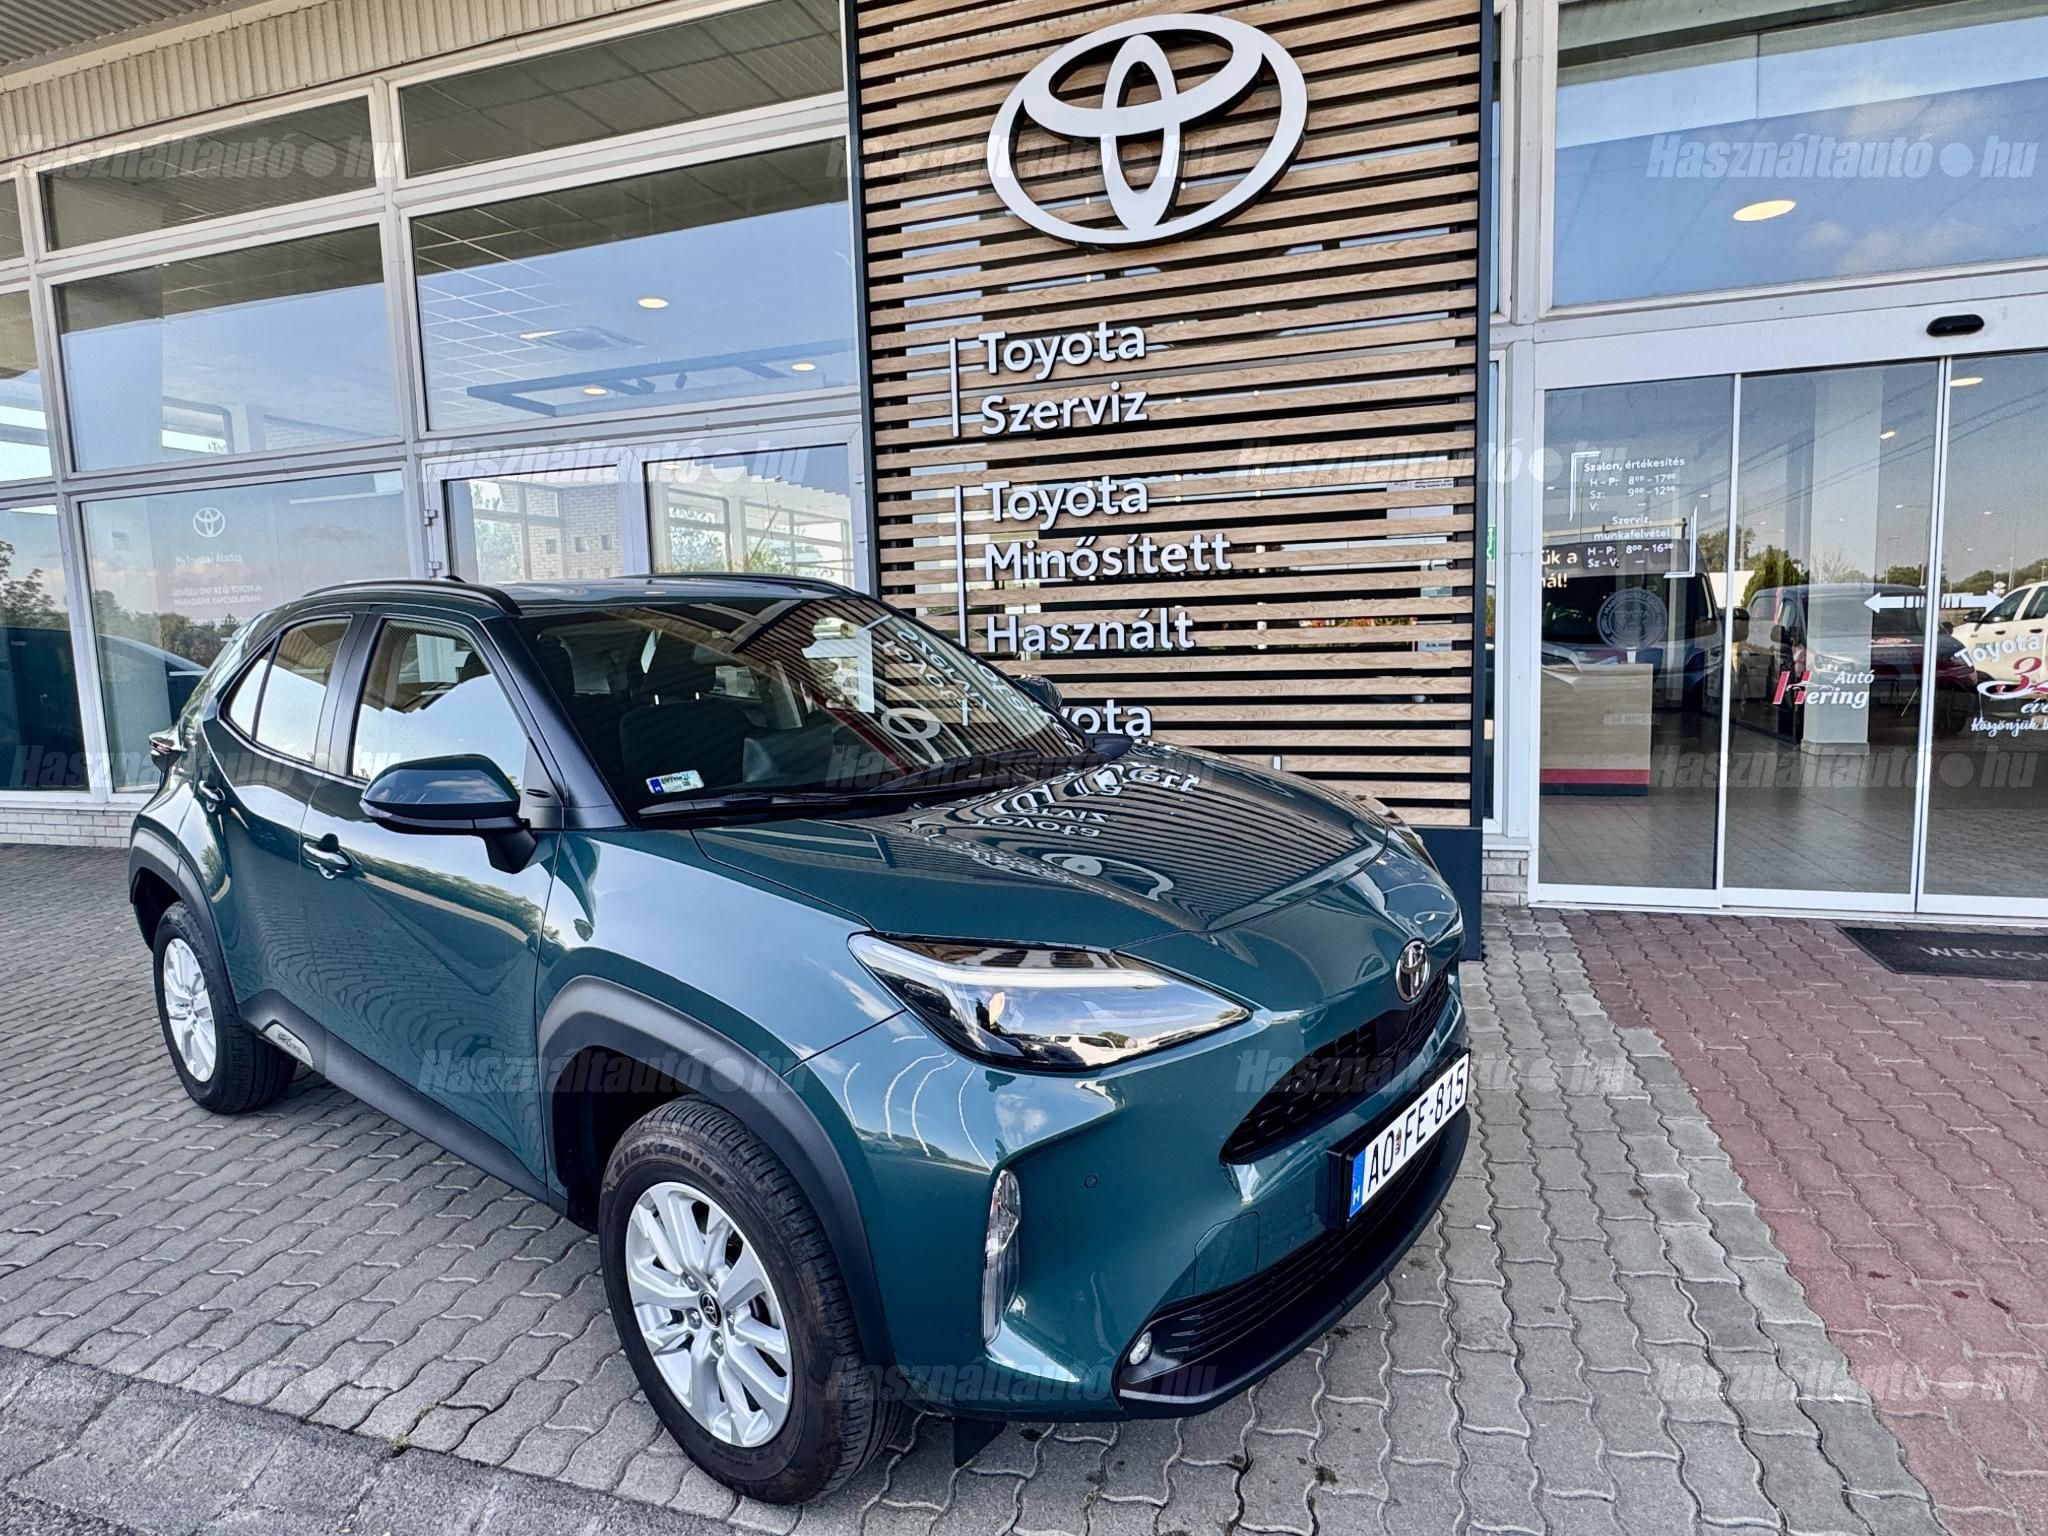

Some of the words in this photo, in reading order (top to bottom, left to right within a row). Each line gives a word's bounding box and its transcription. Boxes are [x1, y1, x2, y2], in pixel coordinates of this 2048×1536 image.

[978, 321, 1146, 381] Toyota
[981, 381, 1147, 435] Szerviz
[1584, 462, 1623, 472] Szalon,
[982, 475, 1148, 530] Toyota
[1593, 528, 1671, 541] munkafelvétel
[985, 533, 1232, 580] Minősített
[1567, 552, 1577, 564] a
[987, 607, 1195, 653] Használt
[1954, 634, 2041, 668] Toyota
[1772, 671, 1870, 709] Hering
[1833, 669, 1875, 685] Autó
[1061, 699, 1152, 736] ota
[1971, 717, 2040, 737] Köszönjük
[1368, 1130, 1395, 1193] AO
[1403, 1062, 1466, 1158] FE-815
